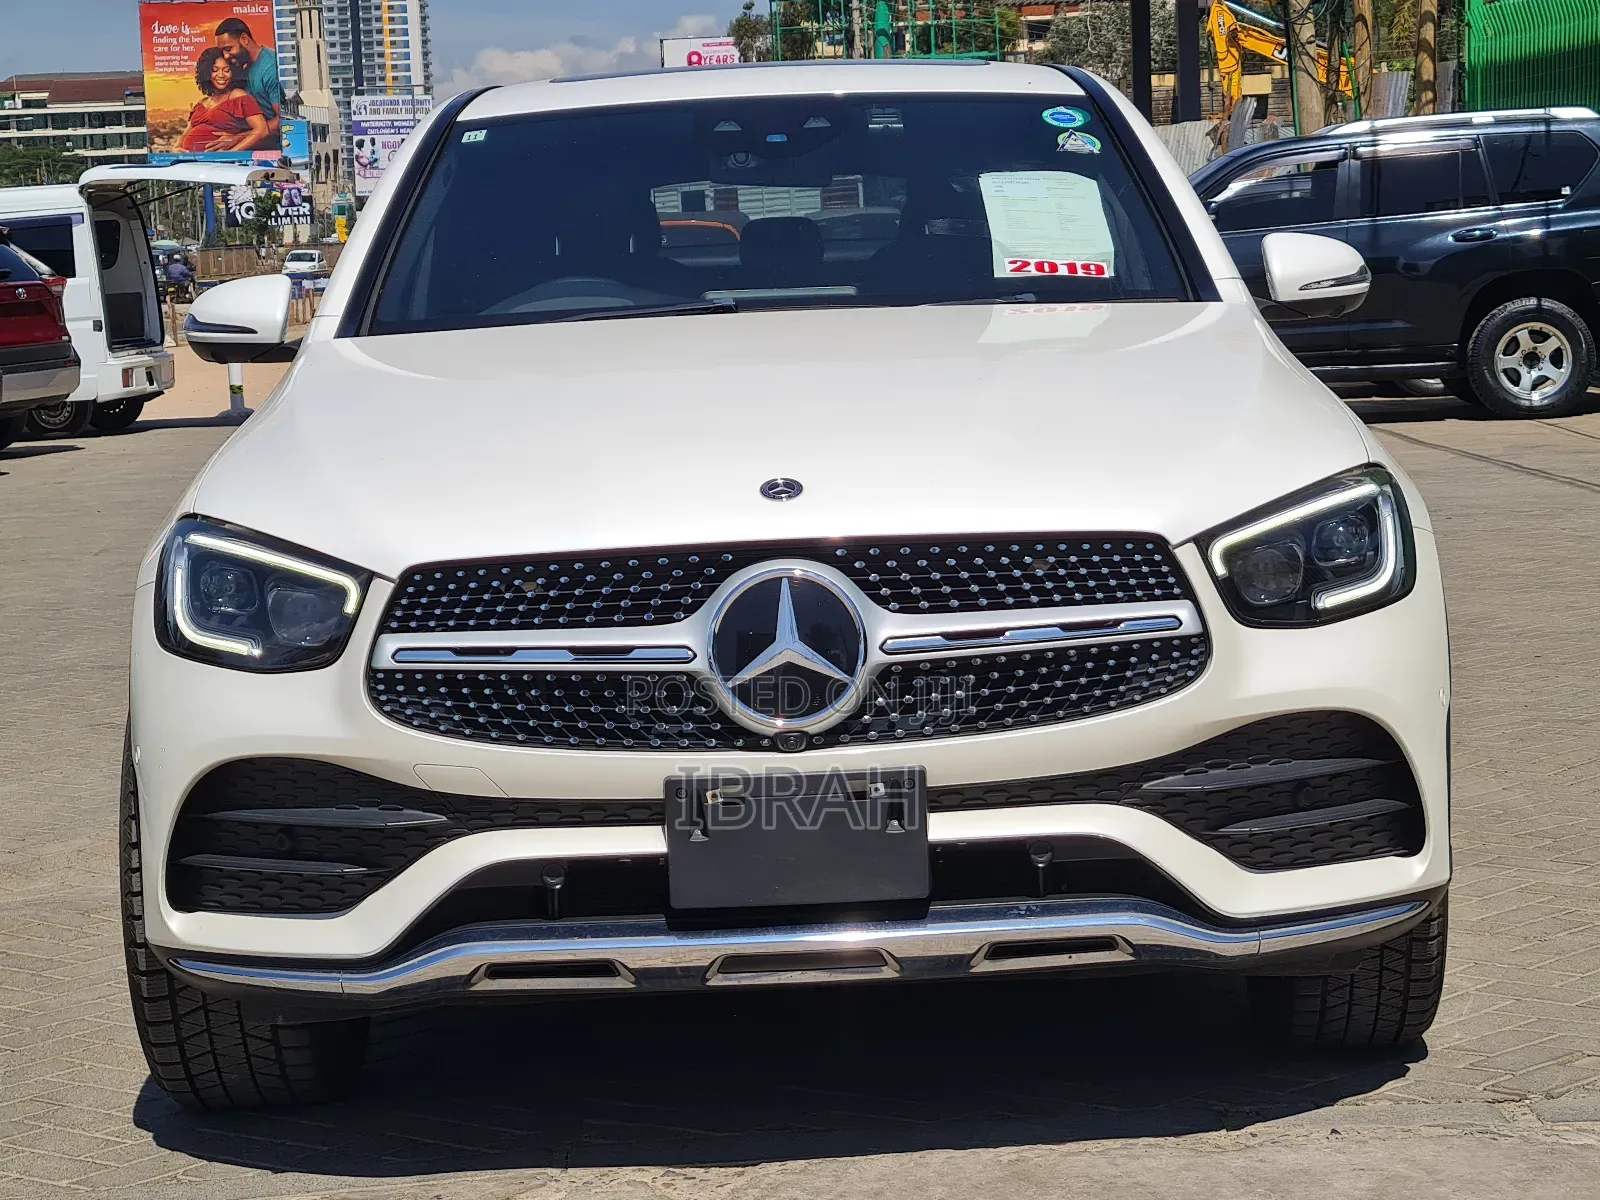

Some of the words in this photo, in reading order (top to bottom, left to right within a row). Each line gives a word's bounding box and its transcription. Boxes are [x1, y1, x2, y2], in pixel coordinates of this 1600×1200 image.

[233, 4, 269, 14] malaica
[152, 20, 179, 34] Love
[153, 36, 177, 45] finding
[191, 35, 206, 43] best
[170, 44, 180, 52] for
[182, 44, 195, 52] her.
[702, 54, 735, 65] YEARS
[369, 99, 400, 107] JACARANDA
[382, 107, 403, 115] FAMILY
[1007, 259, 1105, 276] 2019
